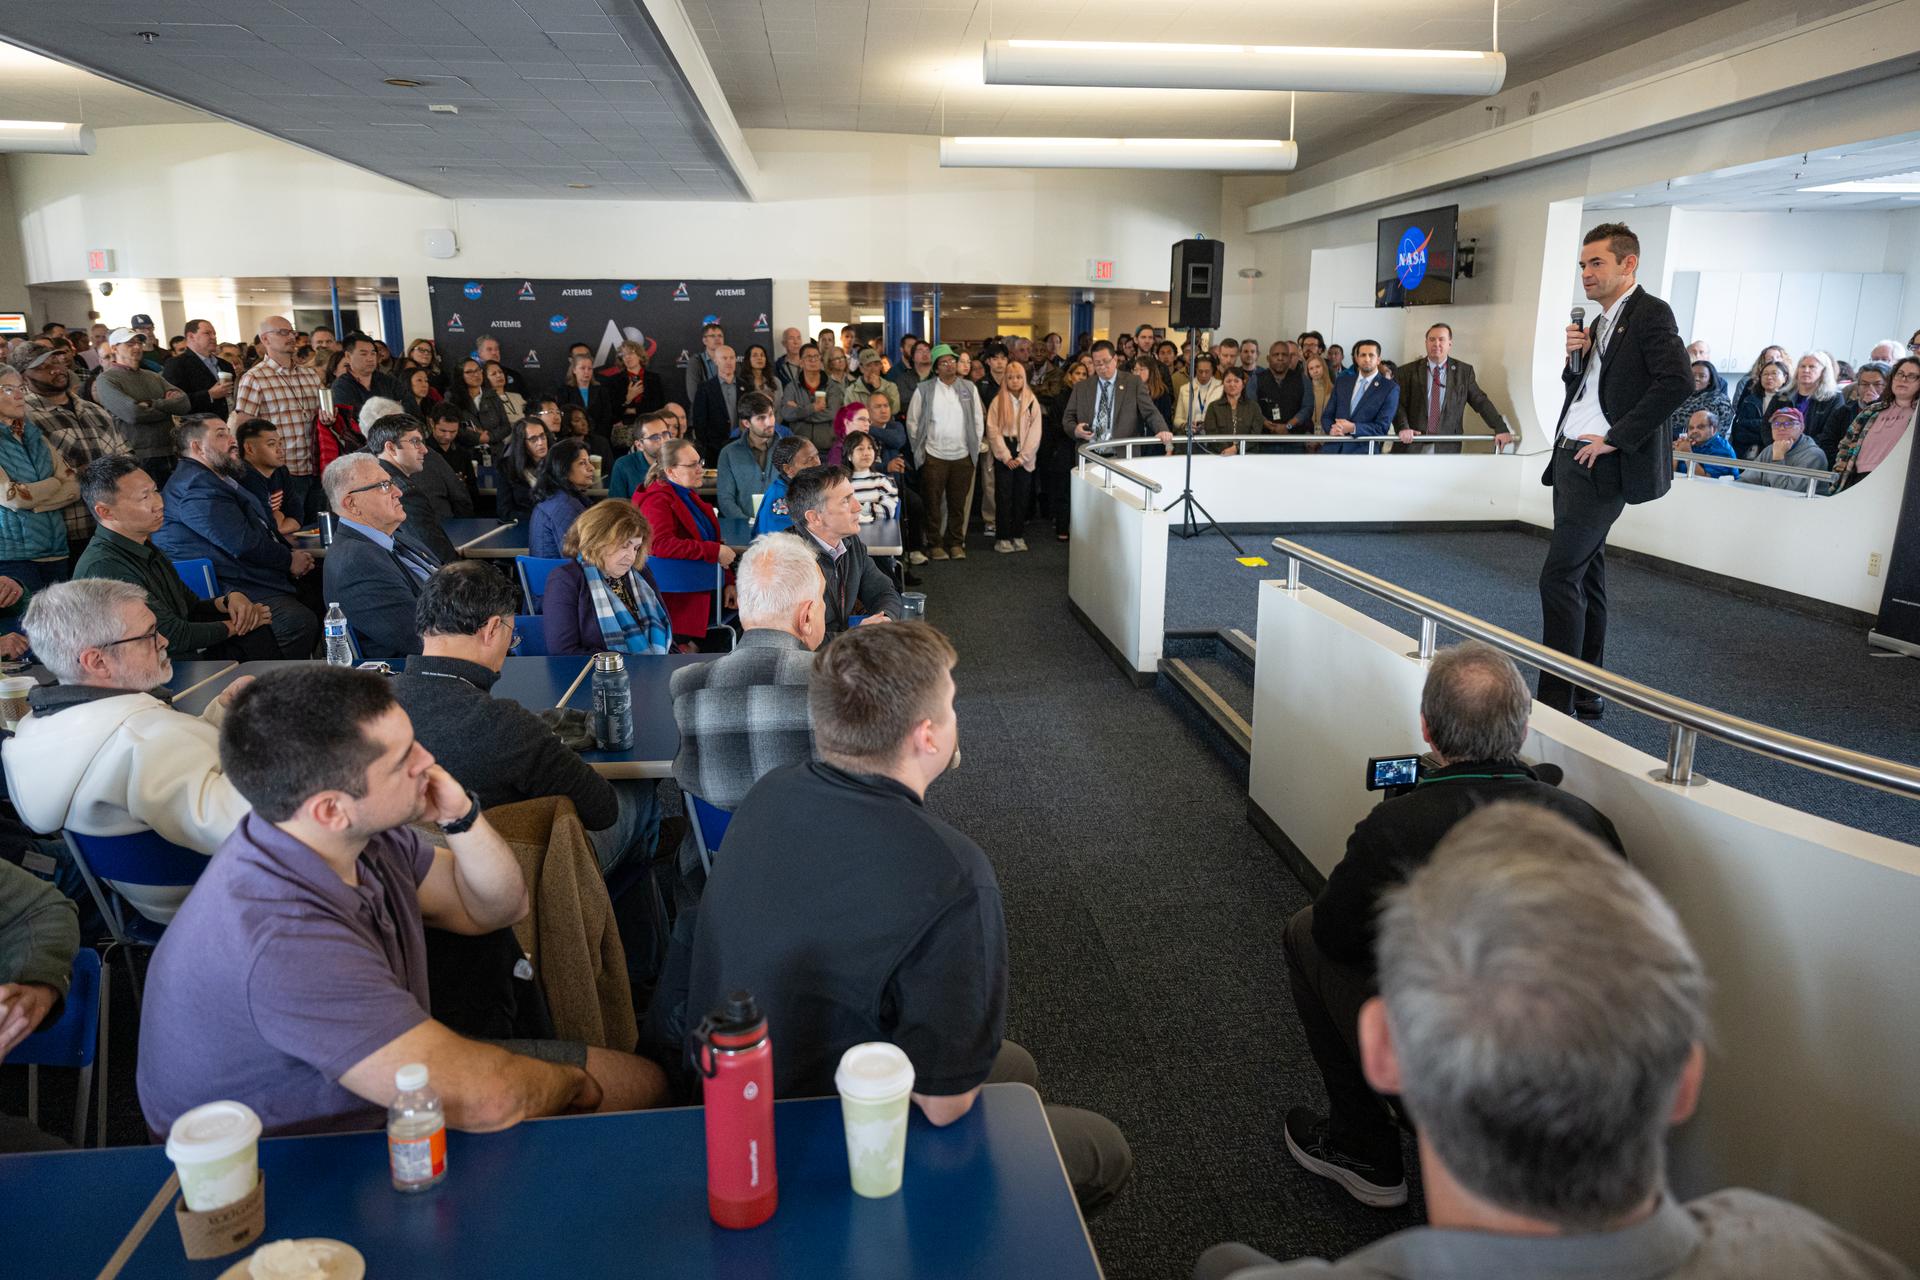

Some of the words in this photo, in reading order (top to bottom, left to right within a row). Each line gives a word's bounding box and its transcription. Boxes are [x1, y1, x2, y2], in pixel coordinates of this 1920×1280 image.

[1398, 250, 1426, 267] NASA
[1096, 261, 1112, 279] EXIT
[562, 288, 593, 296] ARTEMIS
[715, 288, 745, 296] ARTEMIS
[491, 320, 521, 328] ARTEMIS
